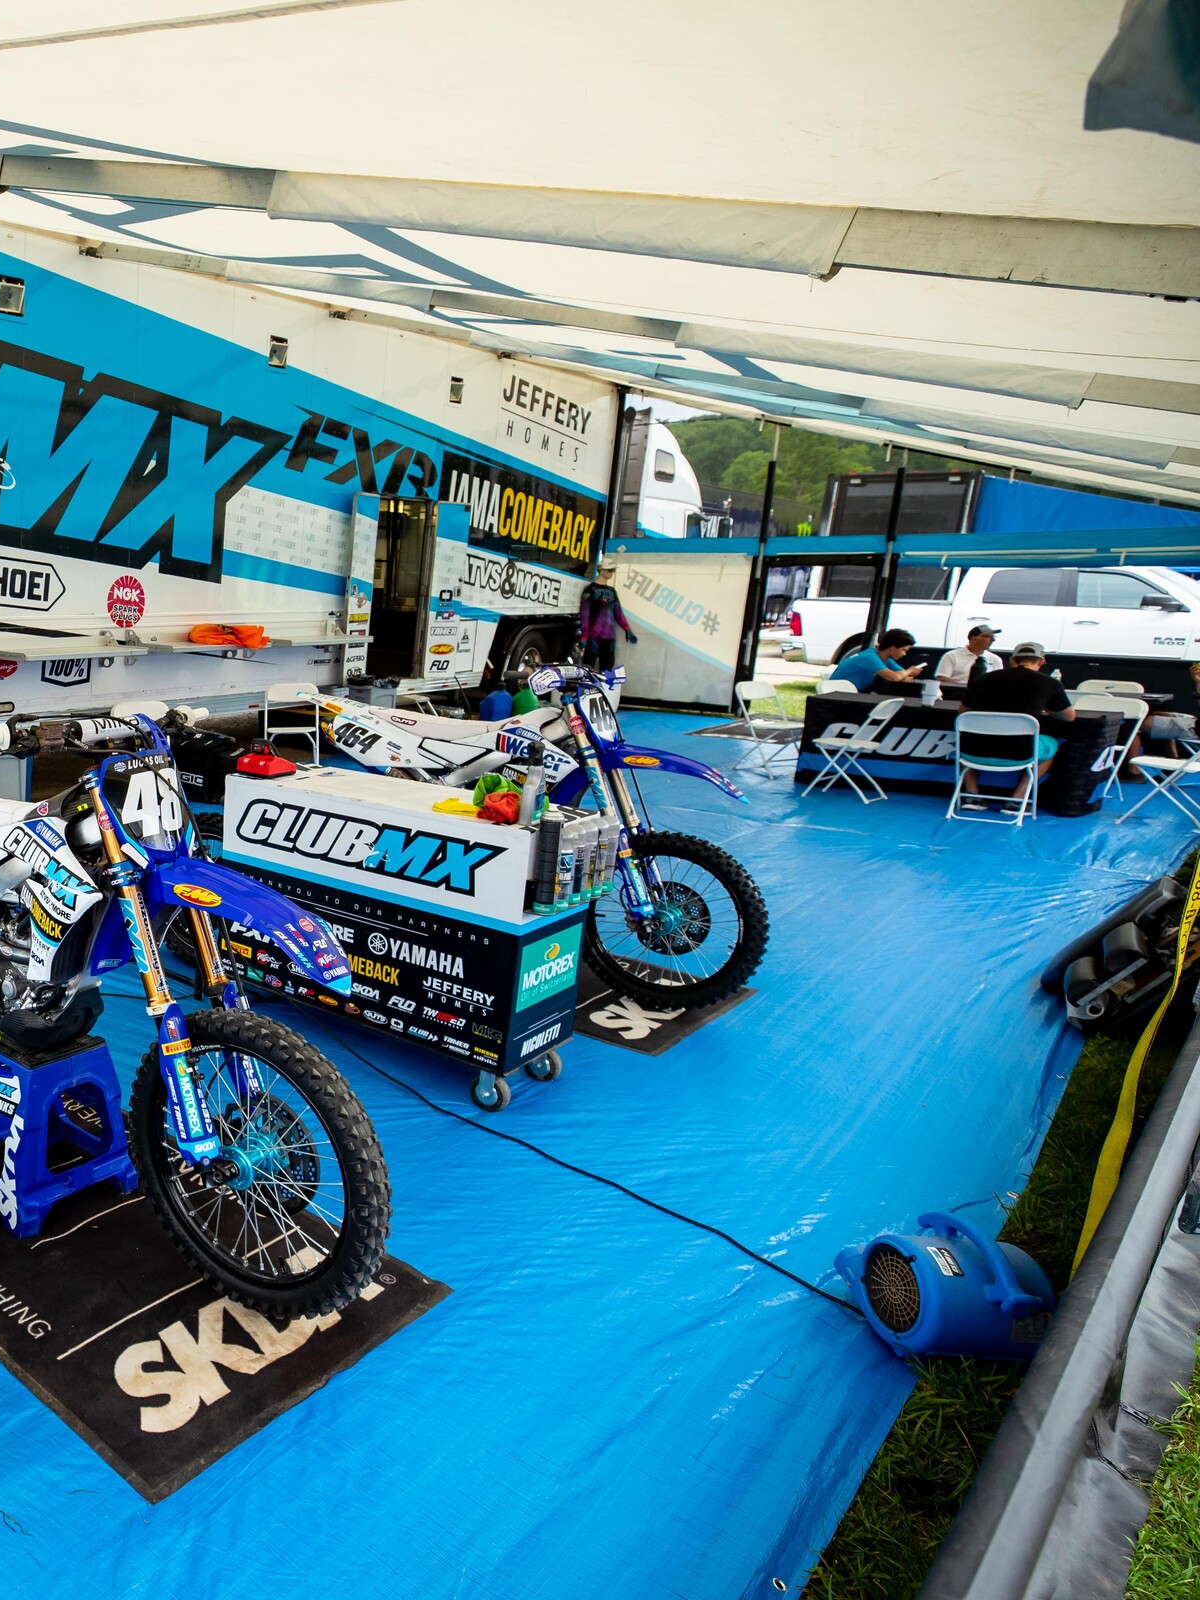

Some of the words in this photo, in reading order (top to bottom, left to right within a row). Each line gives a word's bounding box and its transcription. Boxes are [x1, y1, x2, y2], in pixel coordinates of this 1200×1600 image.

[503, 375, 592, 435] JEFFERY
[285, 404, 438, 498] FXR
[507, 420, 579, 463] HOMES
[113, 604, 138, 614] SPARK
[114, 587, 140, 603] NGK
[113, 612, 138, 622] PLUGS
[48, 659, 85, 678] 100%
[429, 660, 450, 671] FLO
[335, 722, 382, 754] 464
[154, 755, 165, 765] OIL
[506, 736, 571, 771] Weer
[121, 768, 182, 837] 48
[42, 824, 63, 848] YAMAHA
[238, 799, 505, 895] CLUBMX
[174, 887, 222, 904] FMF
[230, 920, 280, 948] FX
[325, 895, 339, 904] TO
[354, 904, 382, 916] OUR
[397, 915, 490, 945] PARTNERS
[348, 954, 400, 986] MEBACK
[389, 938, 464, 978] YAMAHA
[522, 951, 575, 992] MOTOREX
[351, 982, 380, 1000] SKDA
[388, 995, 416, 1012] FLO
[422, 976, 495, 1006] JEFFERY
[428, 992, 487, 1016] HOMES
[364, 1010, 387, 1023] GUTS
[408, 1026, 430, 1037] CLUB
[443, 1035, 470, 1049] TAMER
[521, 1023, 561, 1057] NICOLETTI
[179, 1077, 201, 1135] MOTOREX
[173, 1106, 187, 1139] TAMER
[194, 1141, 216, 1153] SKDA
[114, 1282, 385, 1434] SKD
